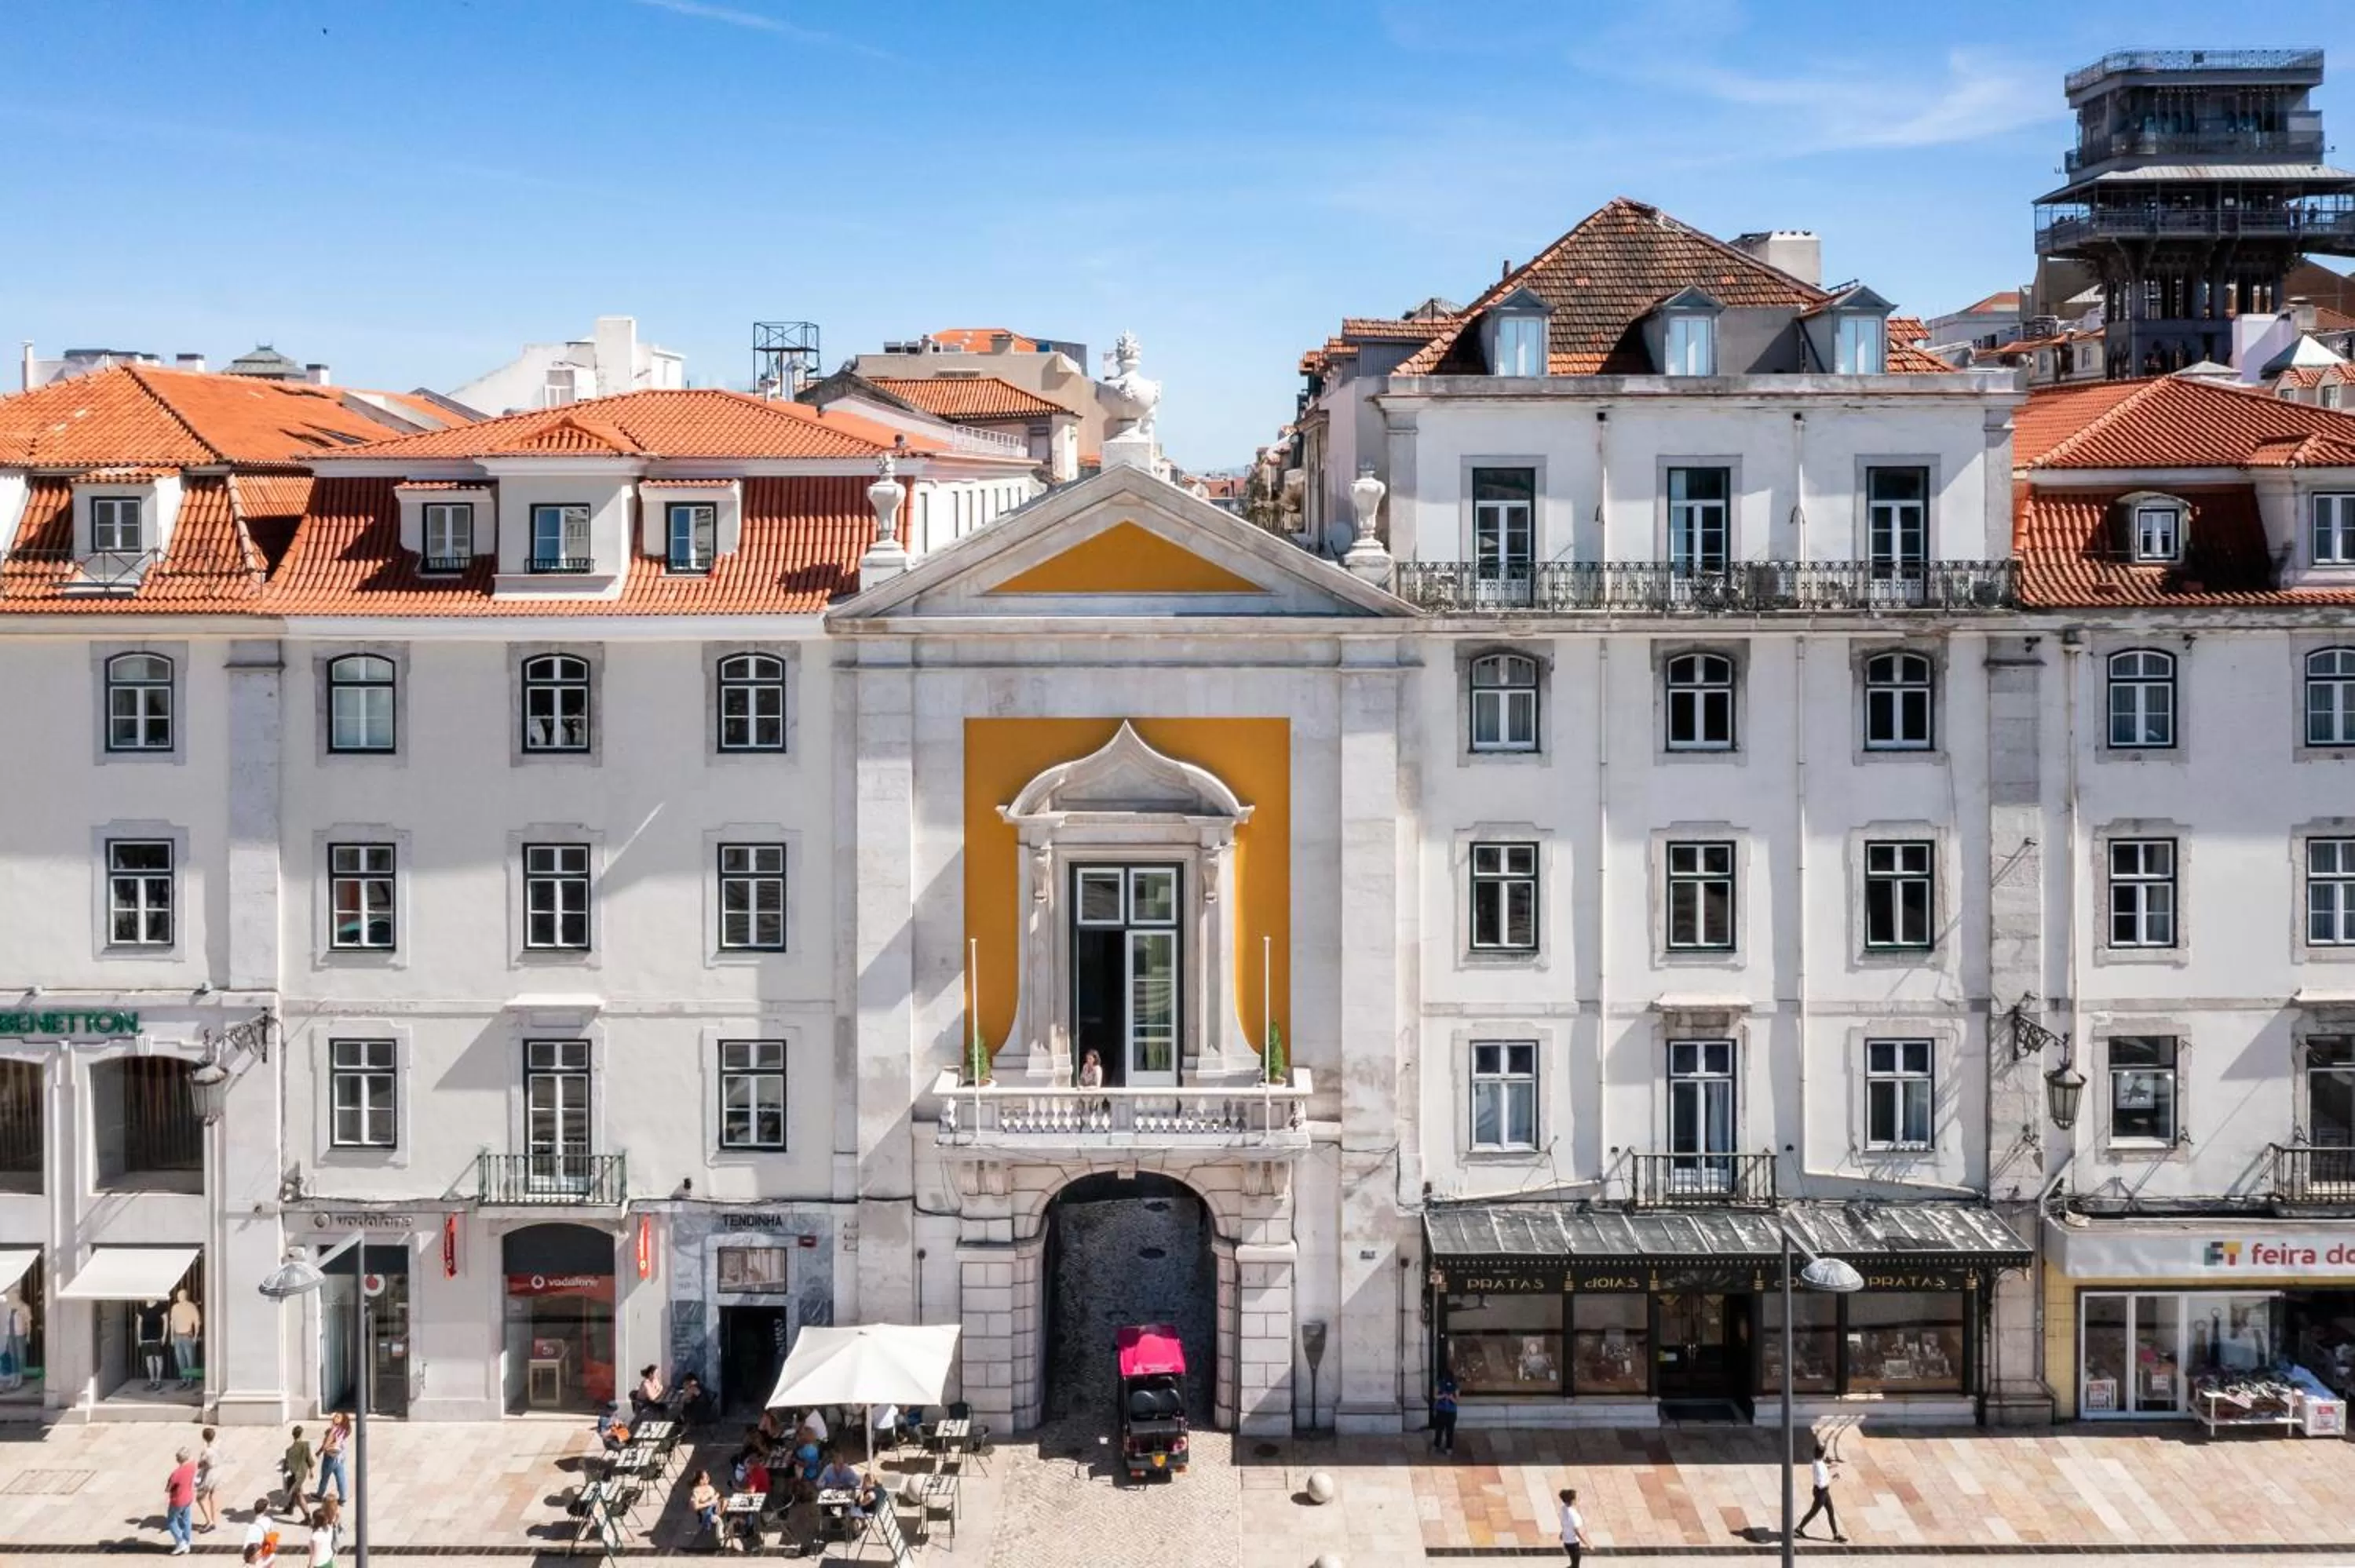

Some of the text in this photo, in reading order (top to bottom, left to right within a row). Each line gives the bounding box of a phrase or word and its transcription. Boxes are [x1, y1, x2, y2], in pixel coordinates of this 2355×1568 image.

[722, 1213, 783, 1227] TENDINHA
[2251, 1242, 2317, 1265] feira
[1466, 1278, 1545, 1289] PRATAS
[1868, 1276, 1948, 1289] PRATAS
